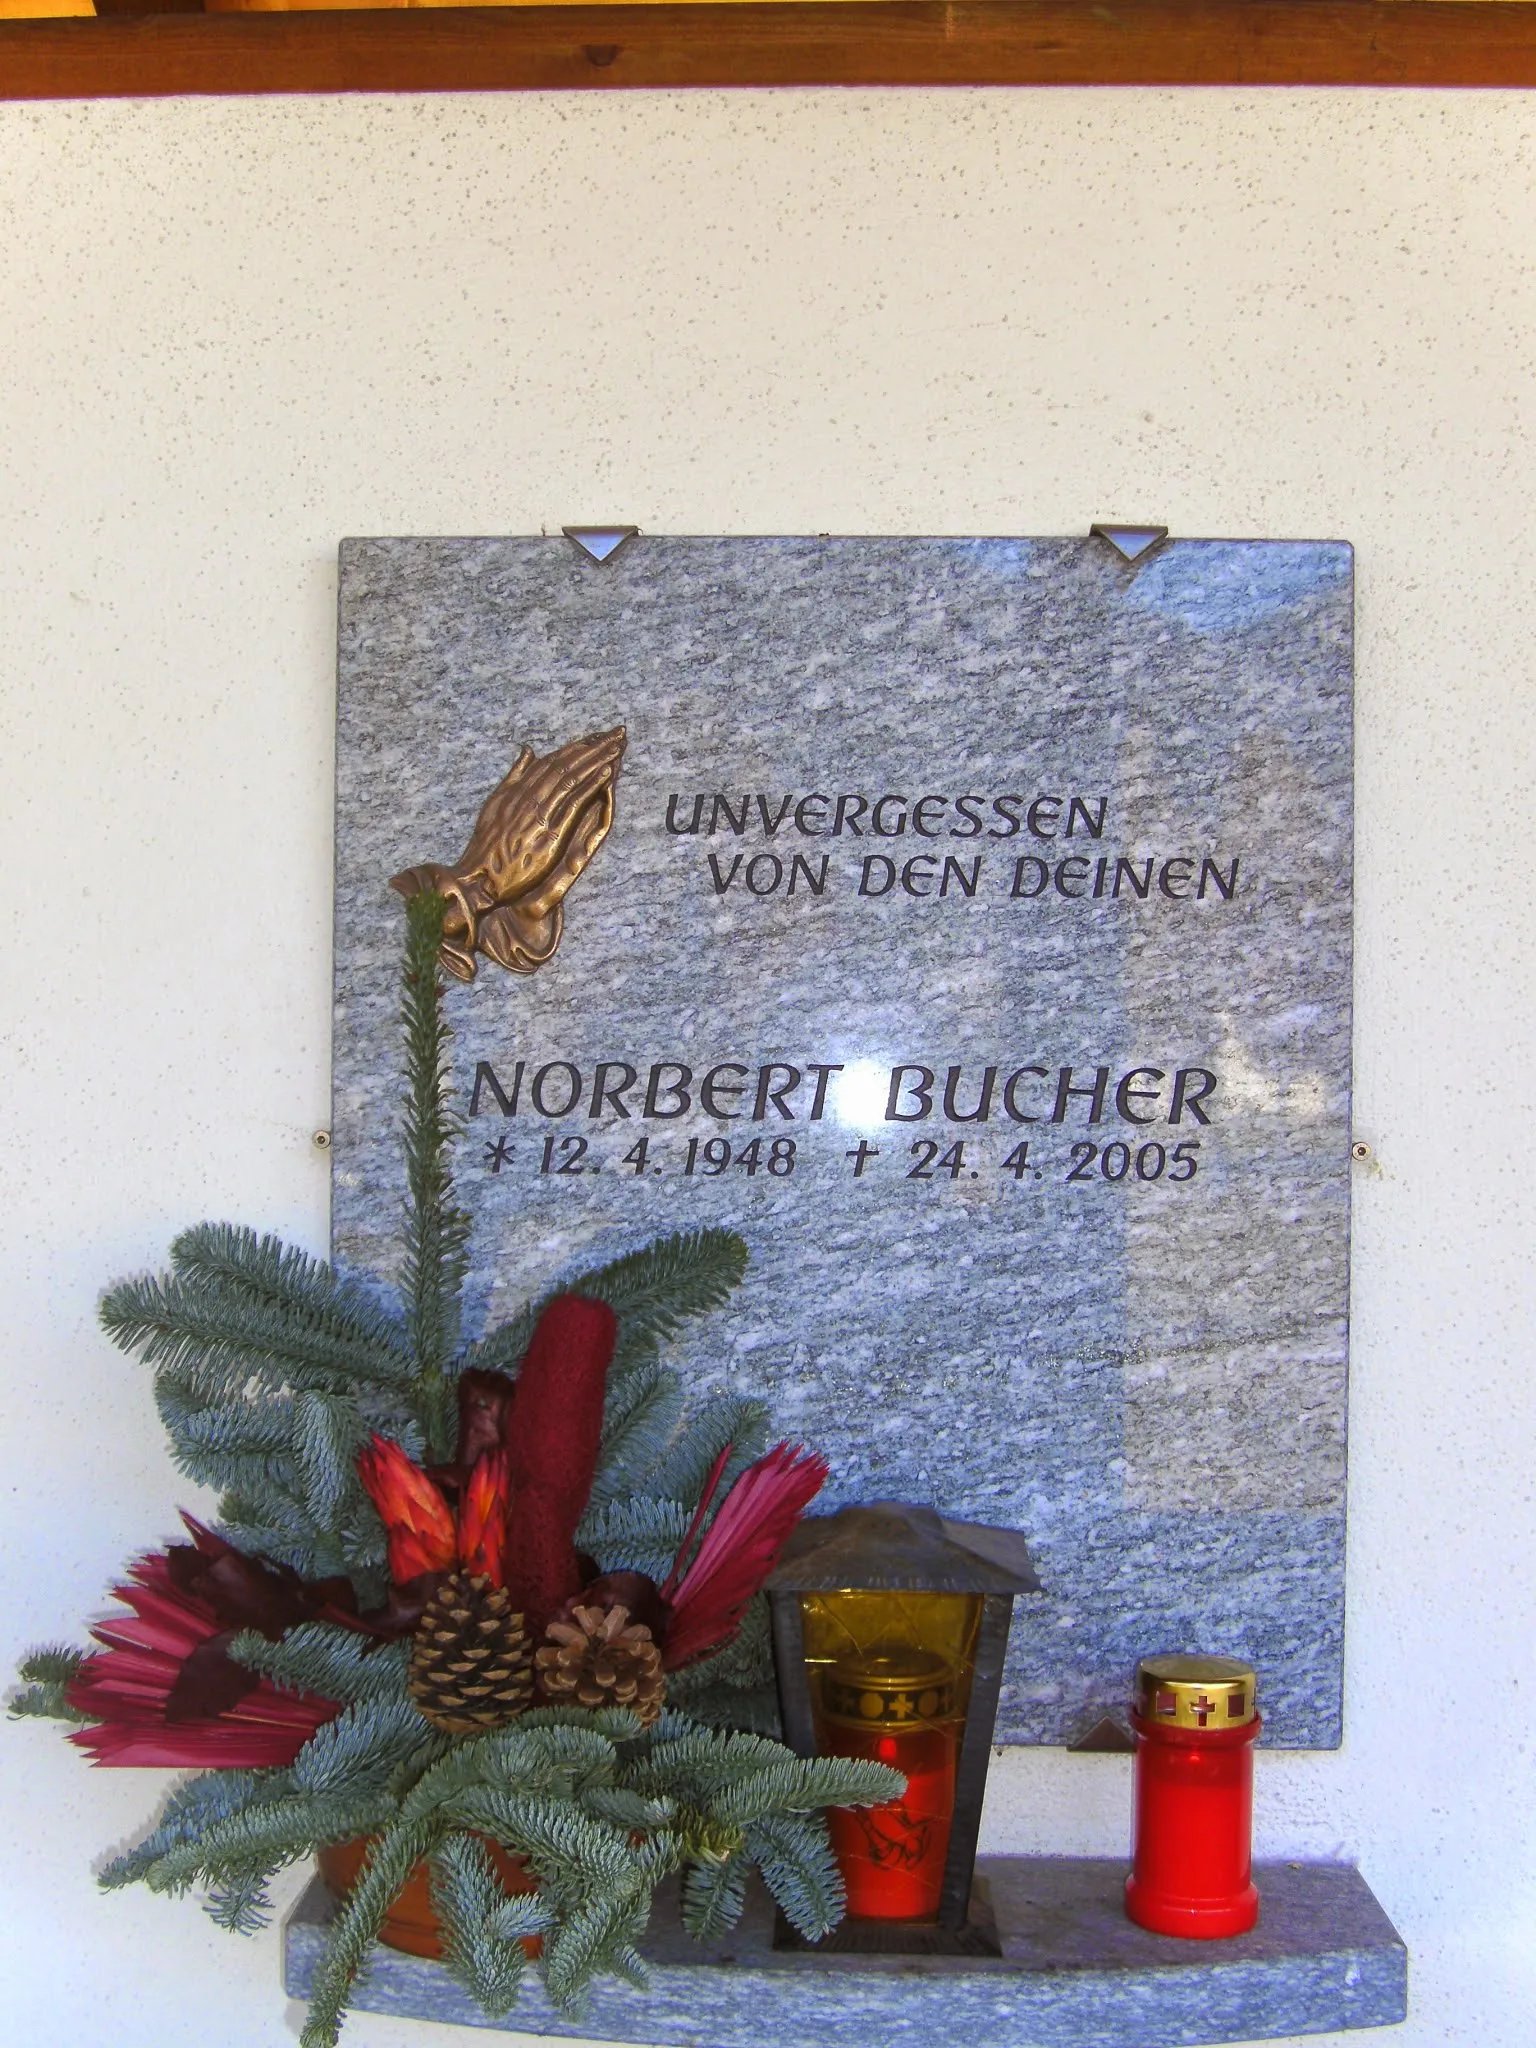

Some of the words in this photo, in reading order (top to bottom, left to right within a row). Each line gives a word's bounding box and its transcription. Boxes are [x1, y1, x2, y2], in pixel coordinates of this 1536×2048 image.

[665, 793, 1108, 838] UNVERGESSEN
[708, 854, 829, 896] VON
[859, 855, 982, 897] DEN
[1011, 856, 1239, 900] DEINEN
[469, 1061, 844, 1121] NORBERT
[885, 1066, 1218, 1125] BUCHER
